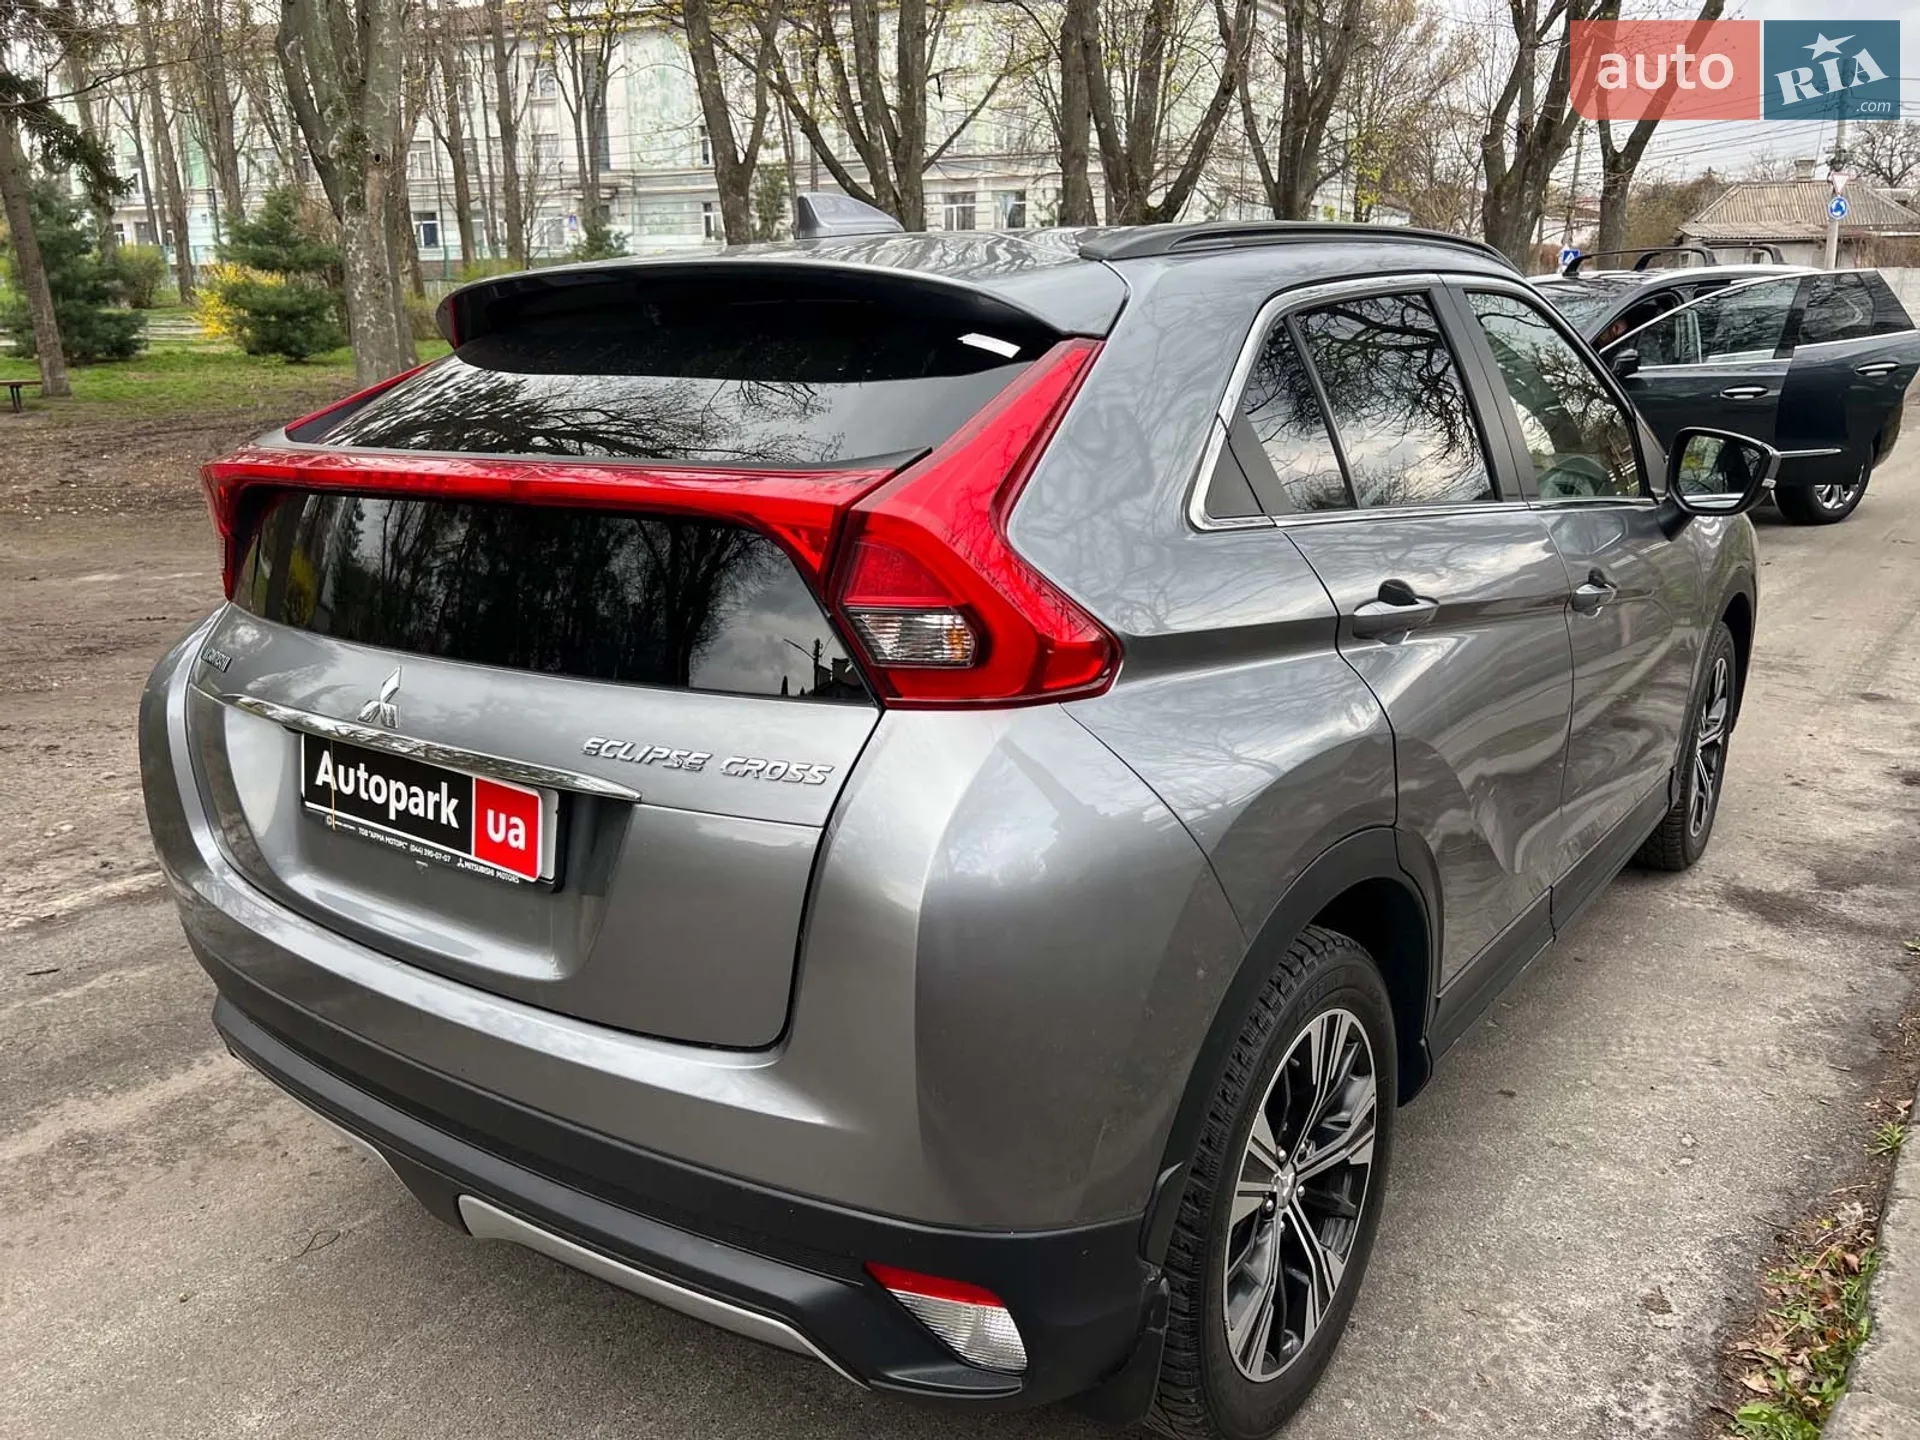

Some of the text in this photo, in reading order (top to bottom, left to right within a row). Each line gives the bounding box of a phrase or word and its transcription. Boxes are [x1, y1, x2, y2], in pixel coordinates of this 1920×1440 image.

[583, 736, 835, 785] ECLIPSE CROSS
[315, 750, 526, 851] Autopark ua
[496, 870, 520, 884] MOTORS
